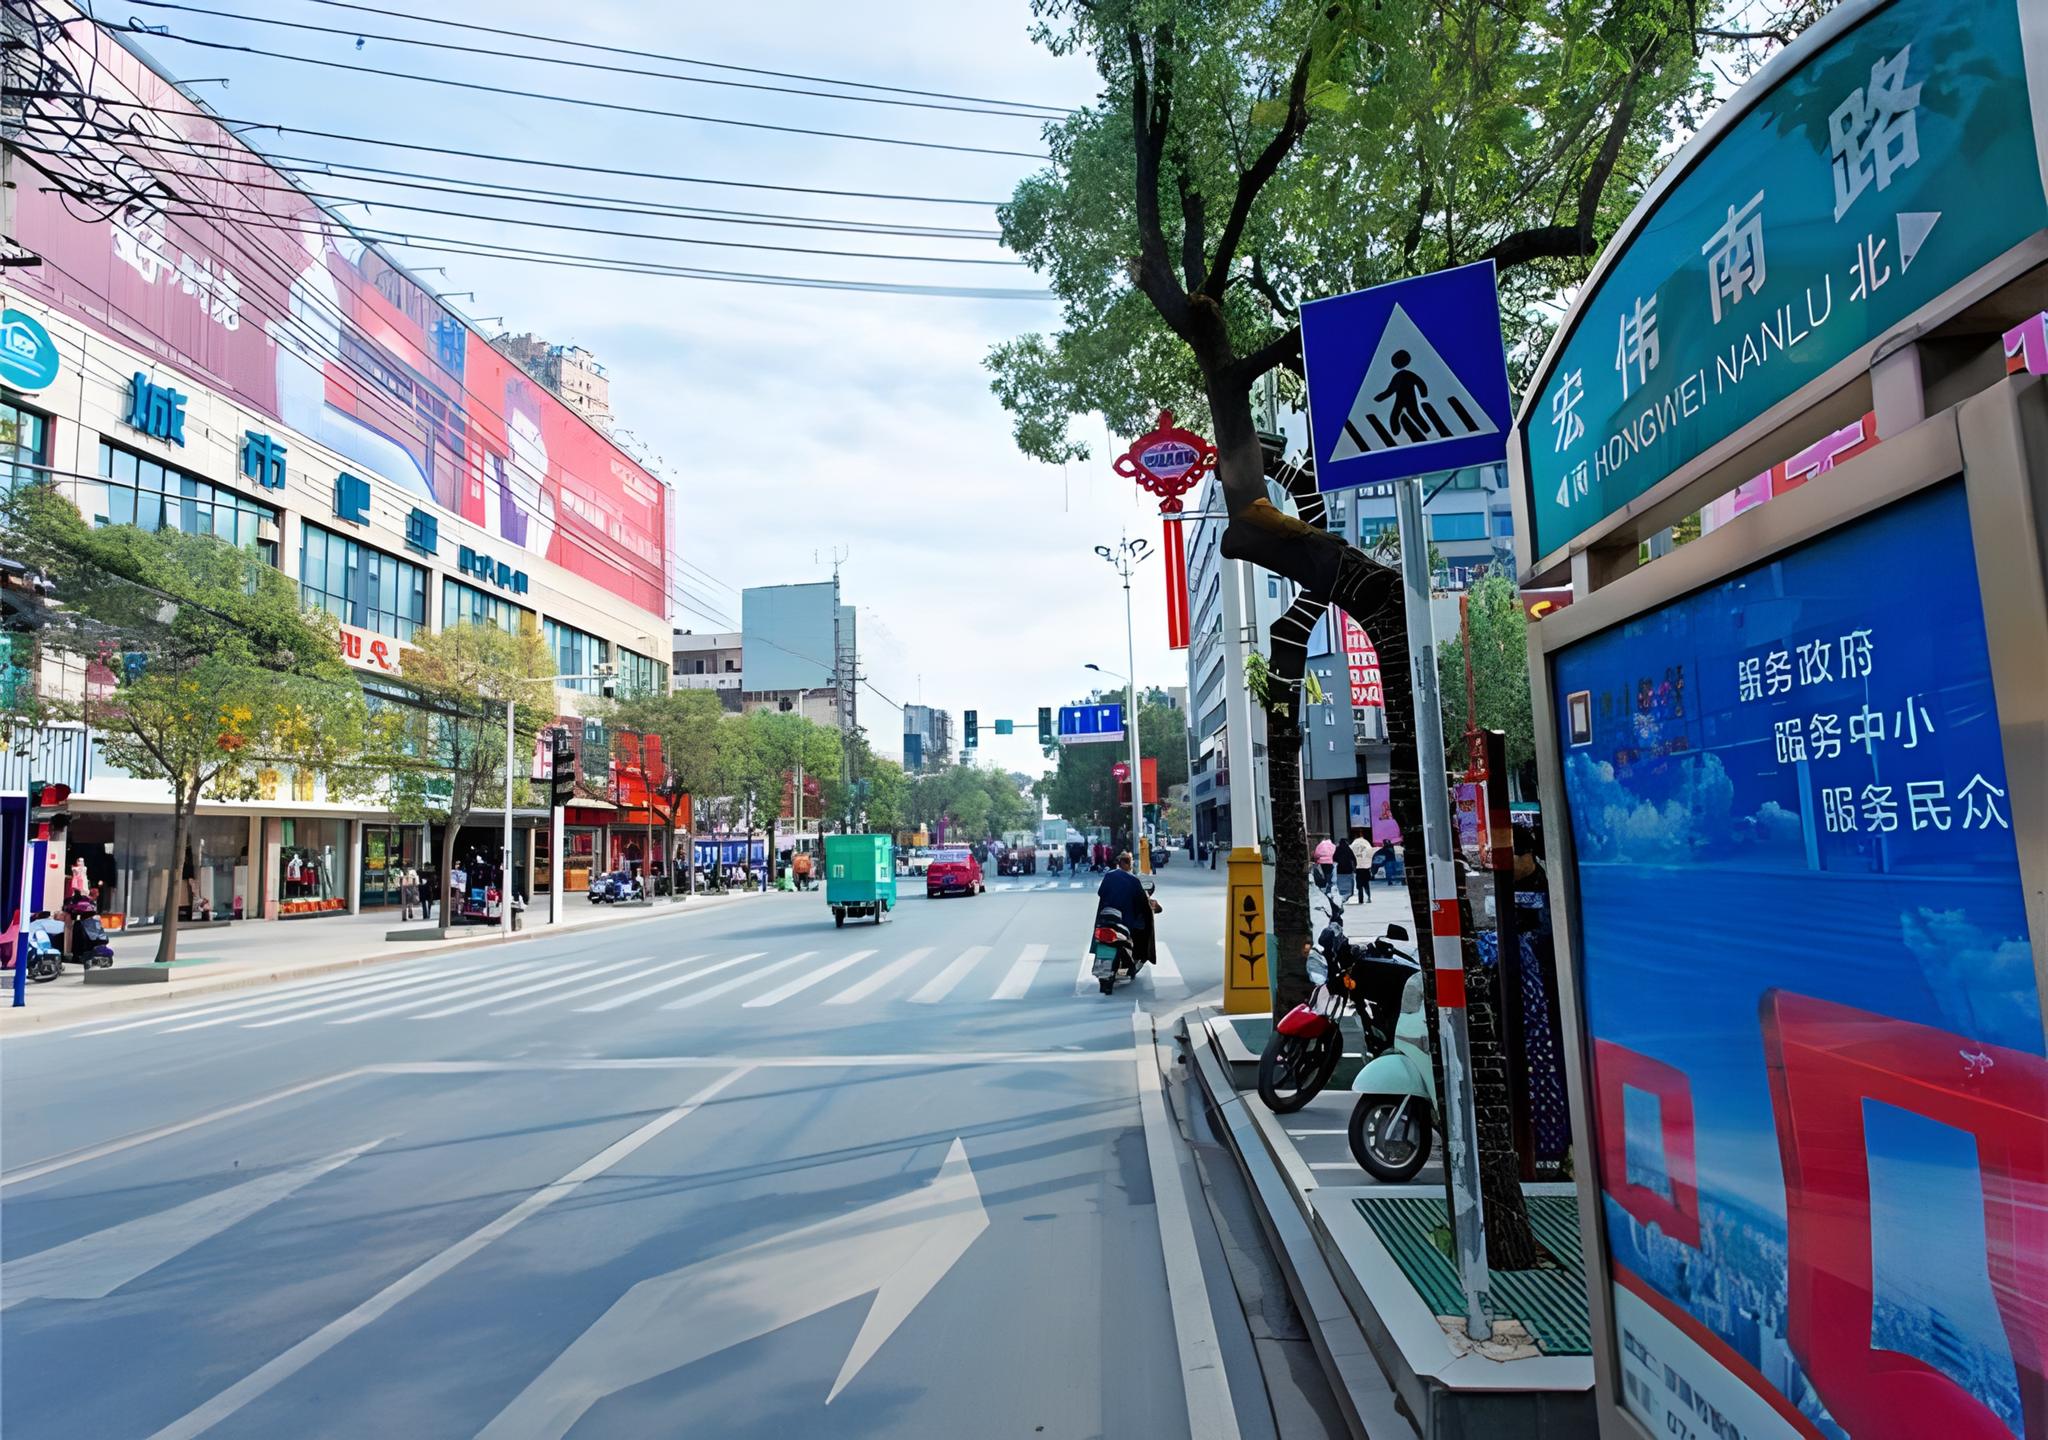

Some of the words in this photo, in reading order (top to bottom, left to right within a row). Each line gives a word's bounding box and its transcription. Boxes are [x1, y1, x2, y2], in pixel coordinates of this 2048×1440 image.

[1551, 43, 1925, 453] 宏伟南路
[1849, 234, 1891, 302] 北
[1594, 367, 1706, 482] HONGWEI
[1716, 274, 1832, 394] NANLU
[1821, 772, 2009, 833] 服务民众
